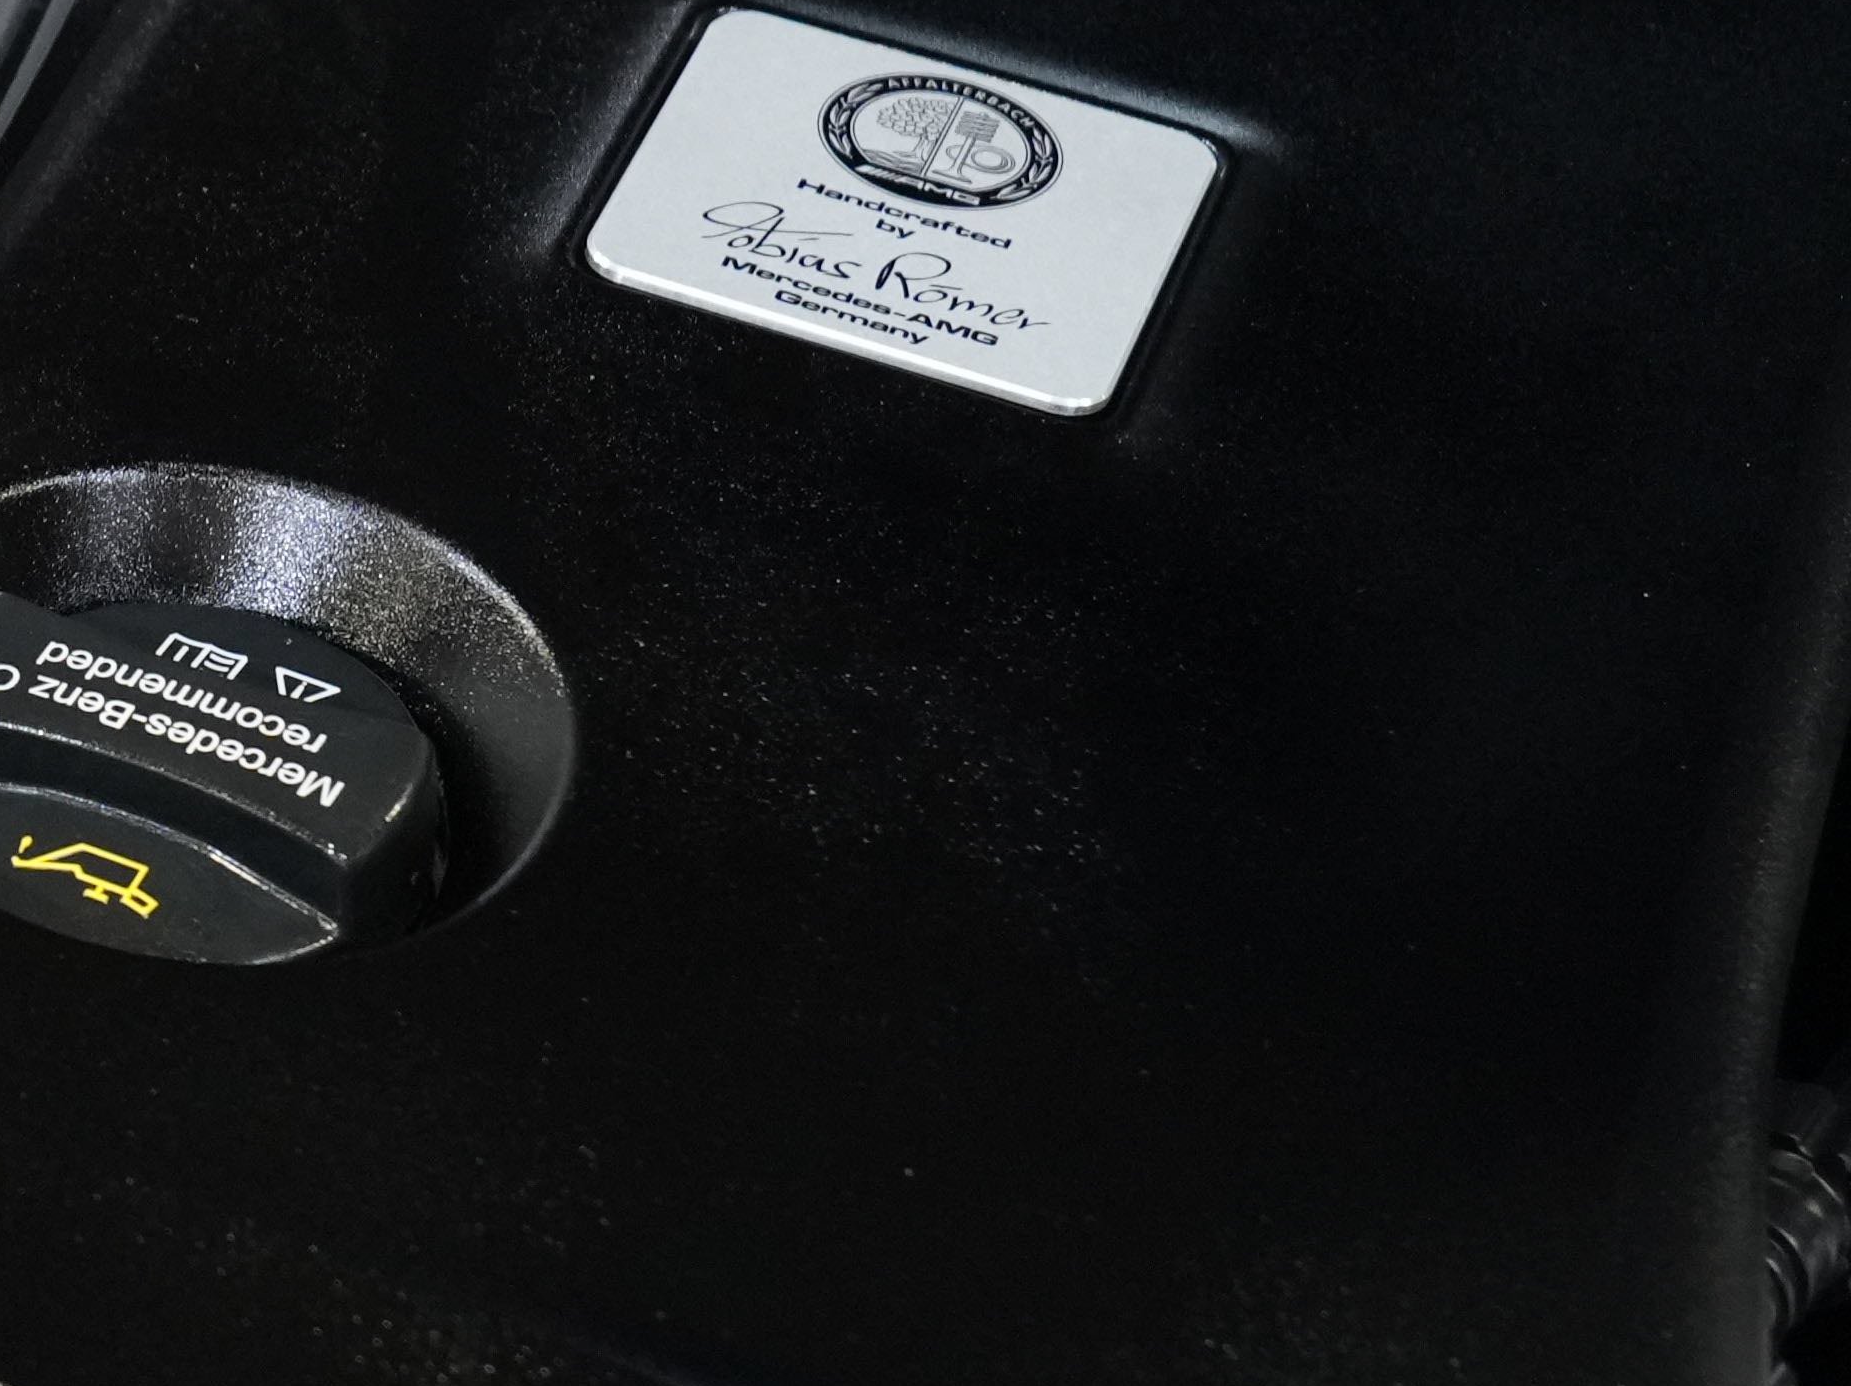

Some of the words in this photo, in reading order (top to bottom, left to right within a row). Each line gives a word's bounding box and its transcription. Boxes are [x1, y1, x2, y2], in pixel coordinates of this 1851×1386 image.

[887, 76, 1035, 127] AFFALTERBACH
[701, 201, 861, 279] Tobias
[797, 178, 1012, 249] Handcrafted
[875, 218, 916, 240] by
[721, 256, 999, 346] Mercedes-AMG
[774, 289, 931, 345] Germany
[36, 641, 327, 754] recommended
[28, 673, 345, 807] Mercedes-Benz
